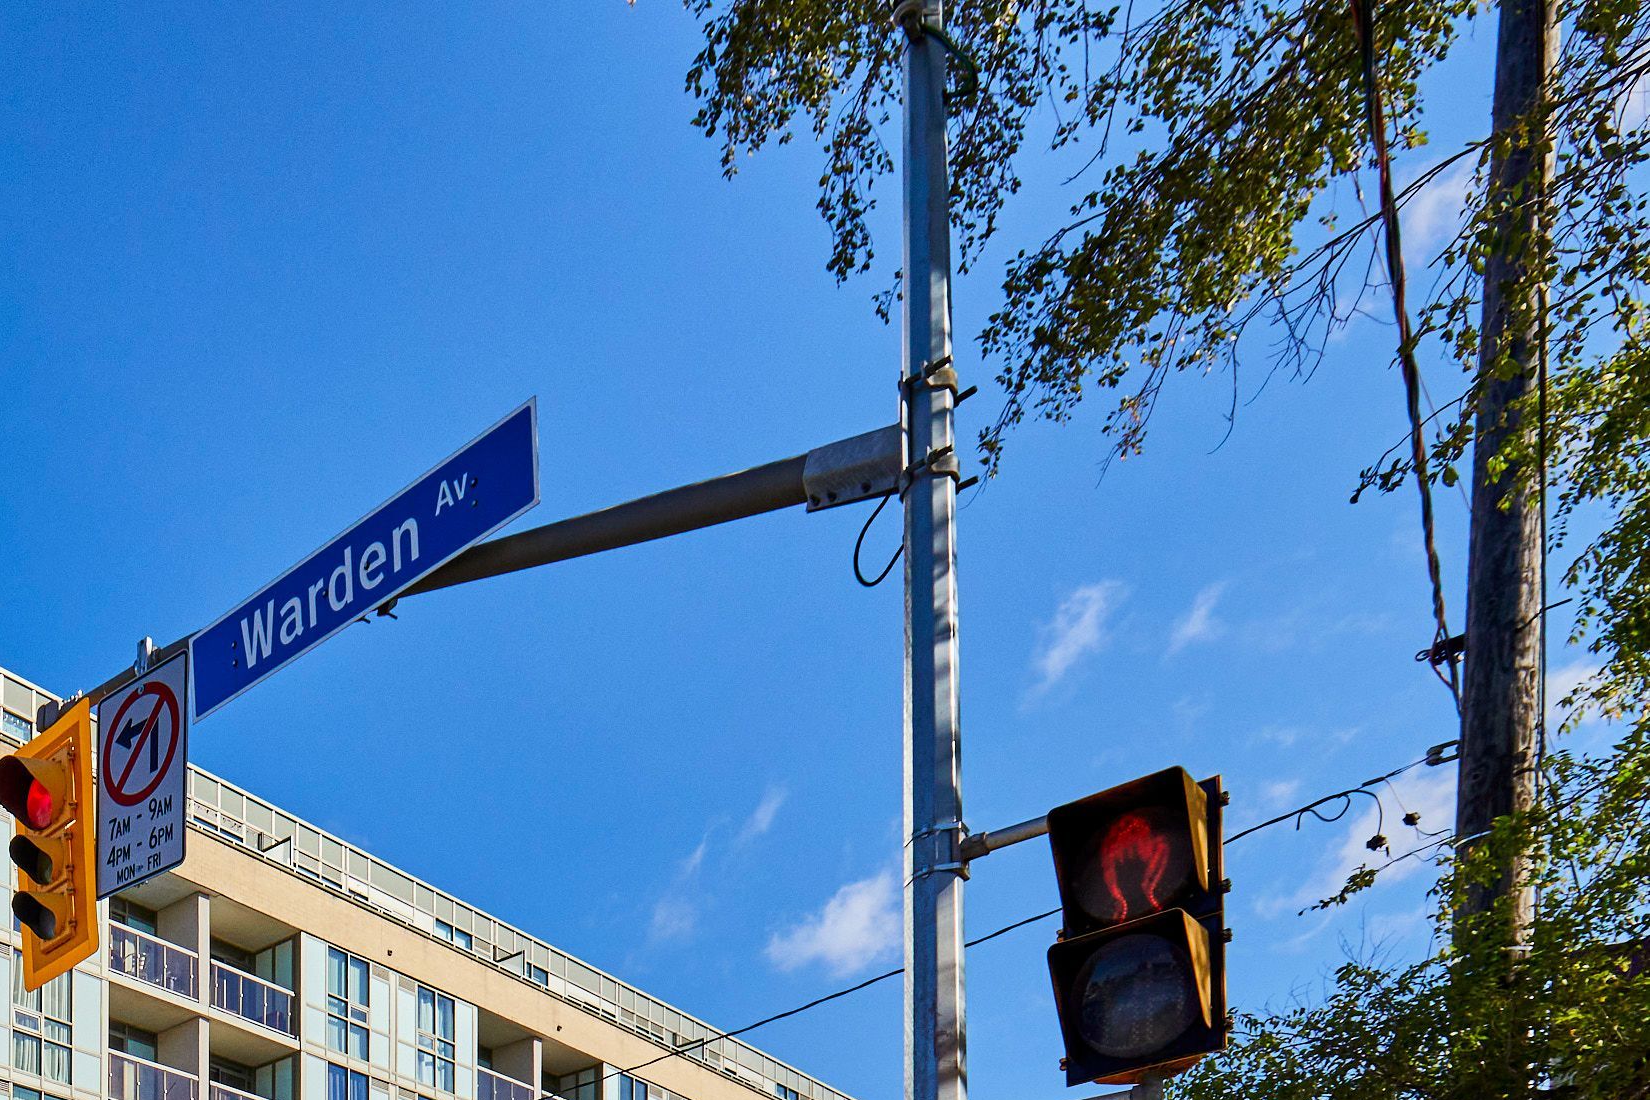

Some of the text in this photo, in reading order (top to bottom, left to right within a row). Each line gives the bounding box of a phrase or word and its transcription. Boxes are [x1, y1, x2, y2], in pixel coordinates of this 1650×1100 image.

[240, 471, 469, 670] Warden Av
[109, 815, 131, 841] 7AM
[148, 794, 173, 821] 9AM
[106, 843, 131, 868] 4PM
[148, 822, 174, 849] 6PM
[116, 863, 136, 885] MON
[147, 851, 161, 871] FRI
